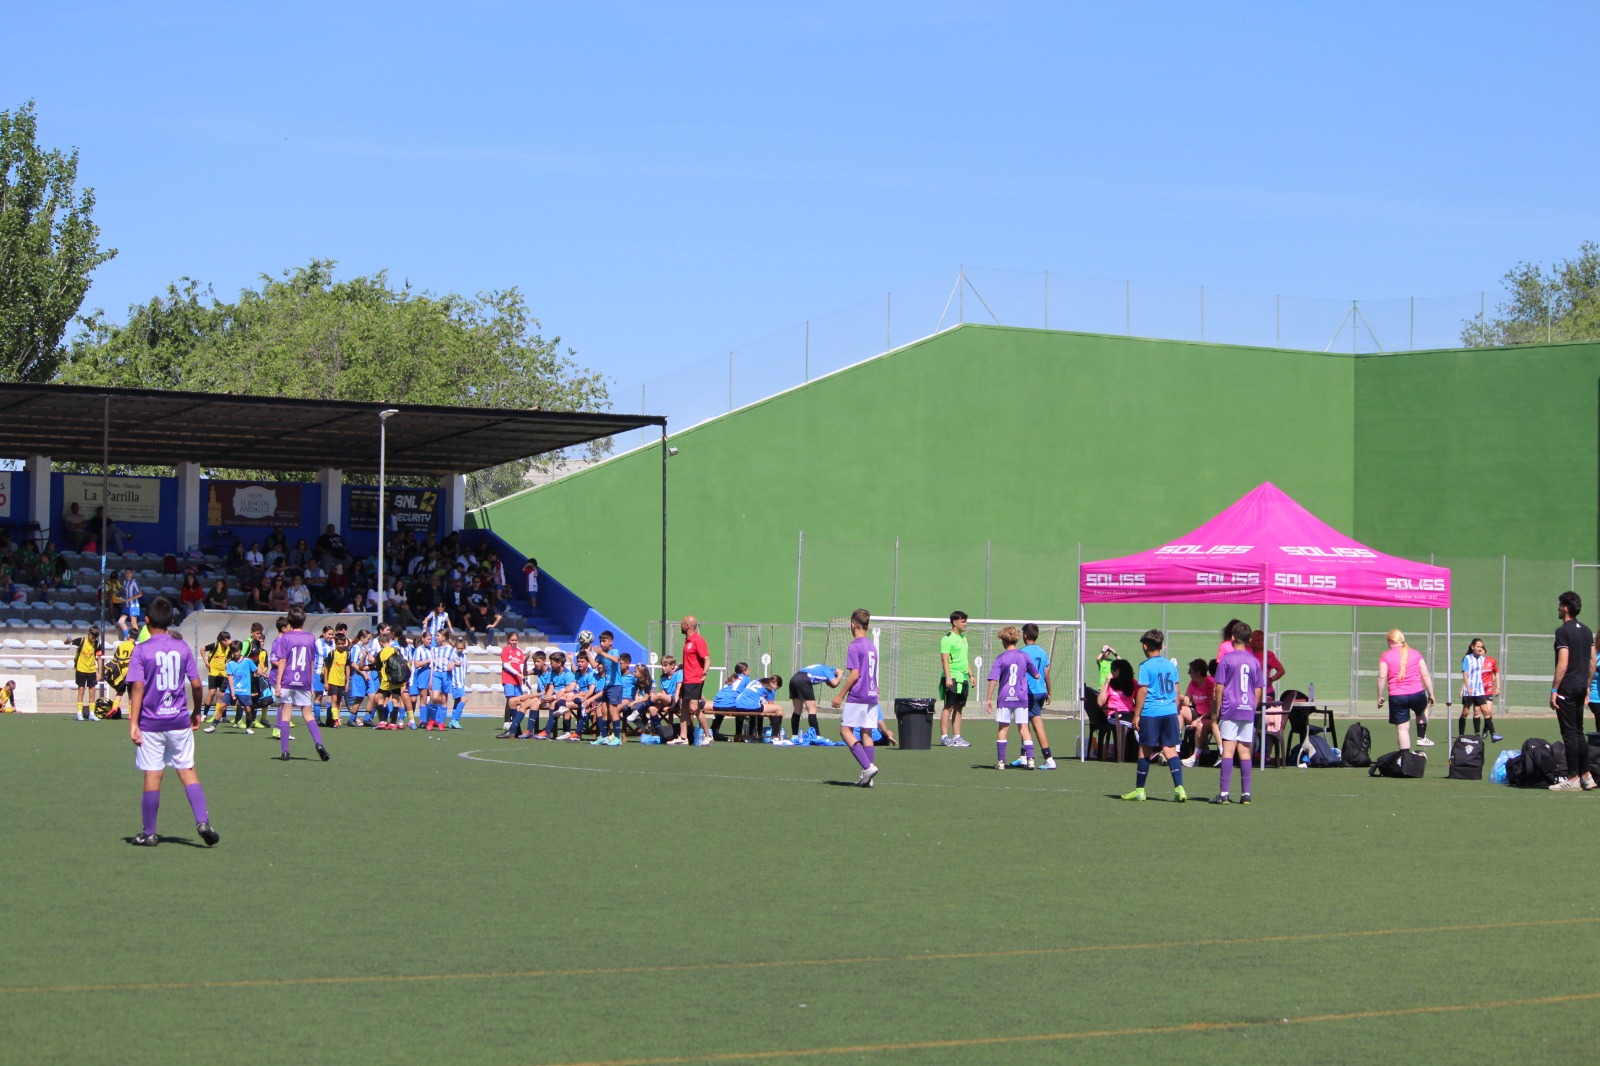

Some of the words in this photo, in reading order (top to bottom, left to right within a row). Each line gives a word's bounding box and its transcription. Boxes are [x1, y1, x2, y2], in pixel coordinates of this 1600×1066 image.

[84, 488, 97, 501] La
[1154, 545, 1255, 554] SOLISS
[1279, 546, 1378, 558] SOLISS
[1086, 573, 1146, 587] SOLISS
[1196, 572, 1260, 586] SOLISS
[1274, 572, 1336, 589] SOLISS
[1385, 577, 1445, 591] SOLISS
[291, 646, 307, 671] 14
[868, 651, 876, 678] 5
[155, 650, 181, 691] 30
[1008, 663, 1019, 686] 8
[1240, 663, 1250, 693] 6
[1157, 672, 1175, 695] 16
